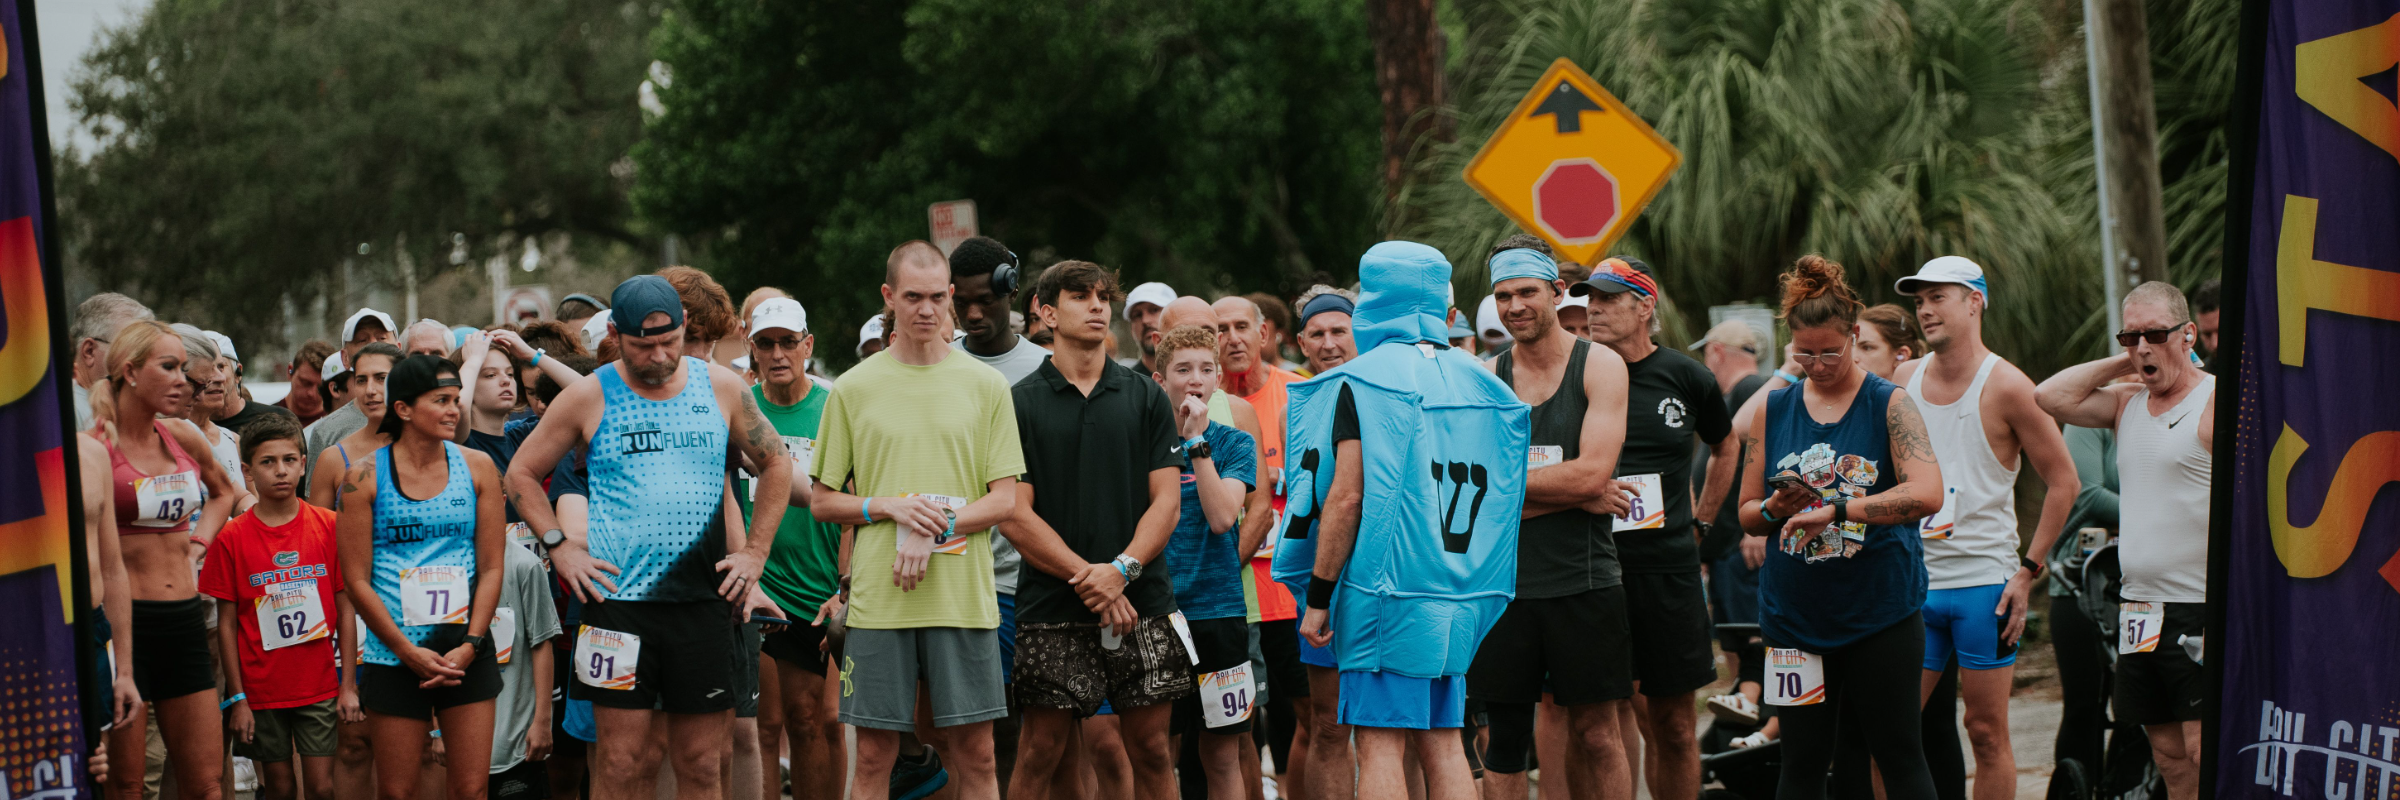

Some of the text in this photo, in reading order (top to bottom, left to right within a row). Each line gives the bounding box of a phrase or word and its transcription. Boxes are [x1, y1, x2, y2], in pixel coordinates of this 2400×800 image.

[156, 497, 184, 522] 43
[1430, 456, 1488, 554] ש
[249, 563, 328, 587] GATORS
[426, 590, 450, 615] 77
[277, 610, 309, 639] 62
[2127, 619, 2146, 646] 51
[589, 652, 615, 681] 91
[1775, 672, 1803, 698] 70
[1222, 688, 1248, 718] 94
